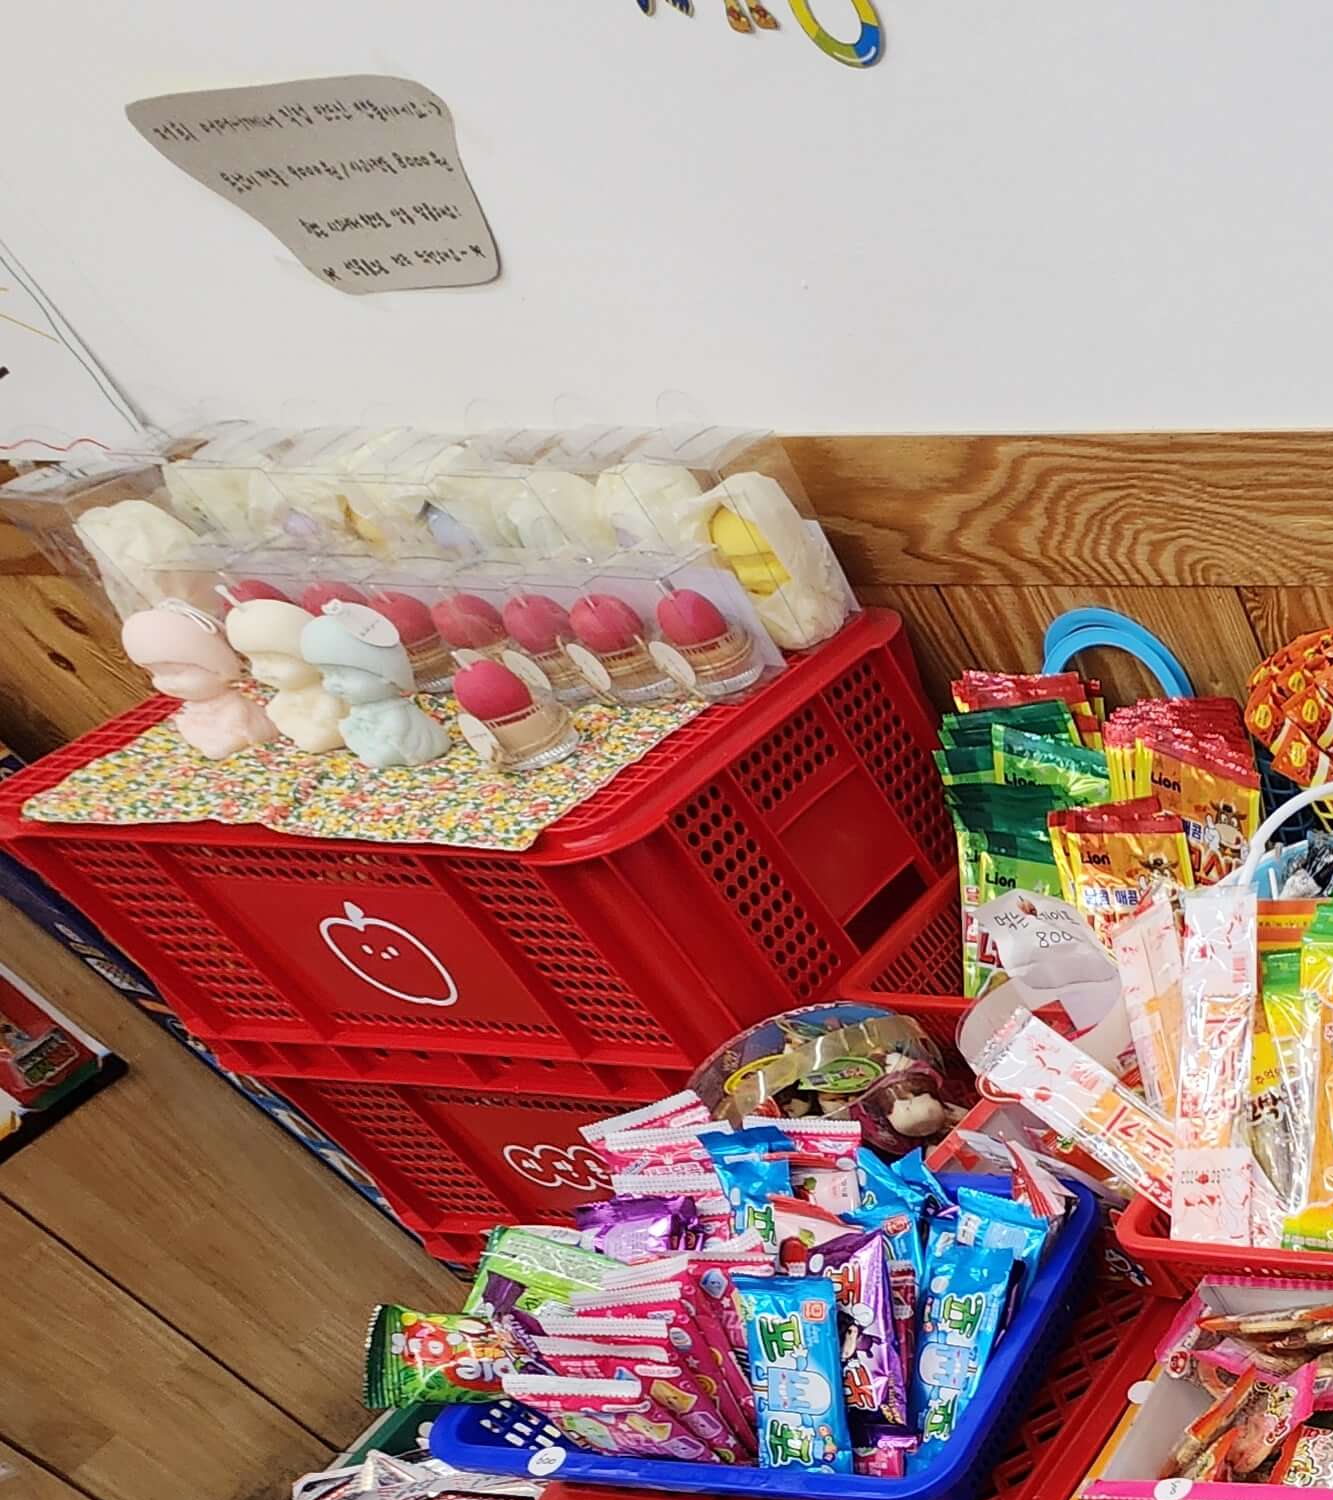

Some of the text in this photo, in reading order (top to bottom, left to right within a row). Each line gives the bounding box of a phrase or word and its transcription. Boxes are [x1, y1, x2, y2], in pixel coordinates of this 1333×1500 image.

[1151, 773, 1182, 793] Lion
[985, 871, 1017, 889] Lion
[993, 908, 1029, 931] 먹는
[1036, 929, 1074, 949] 800
